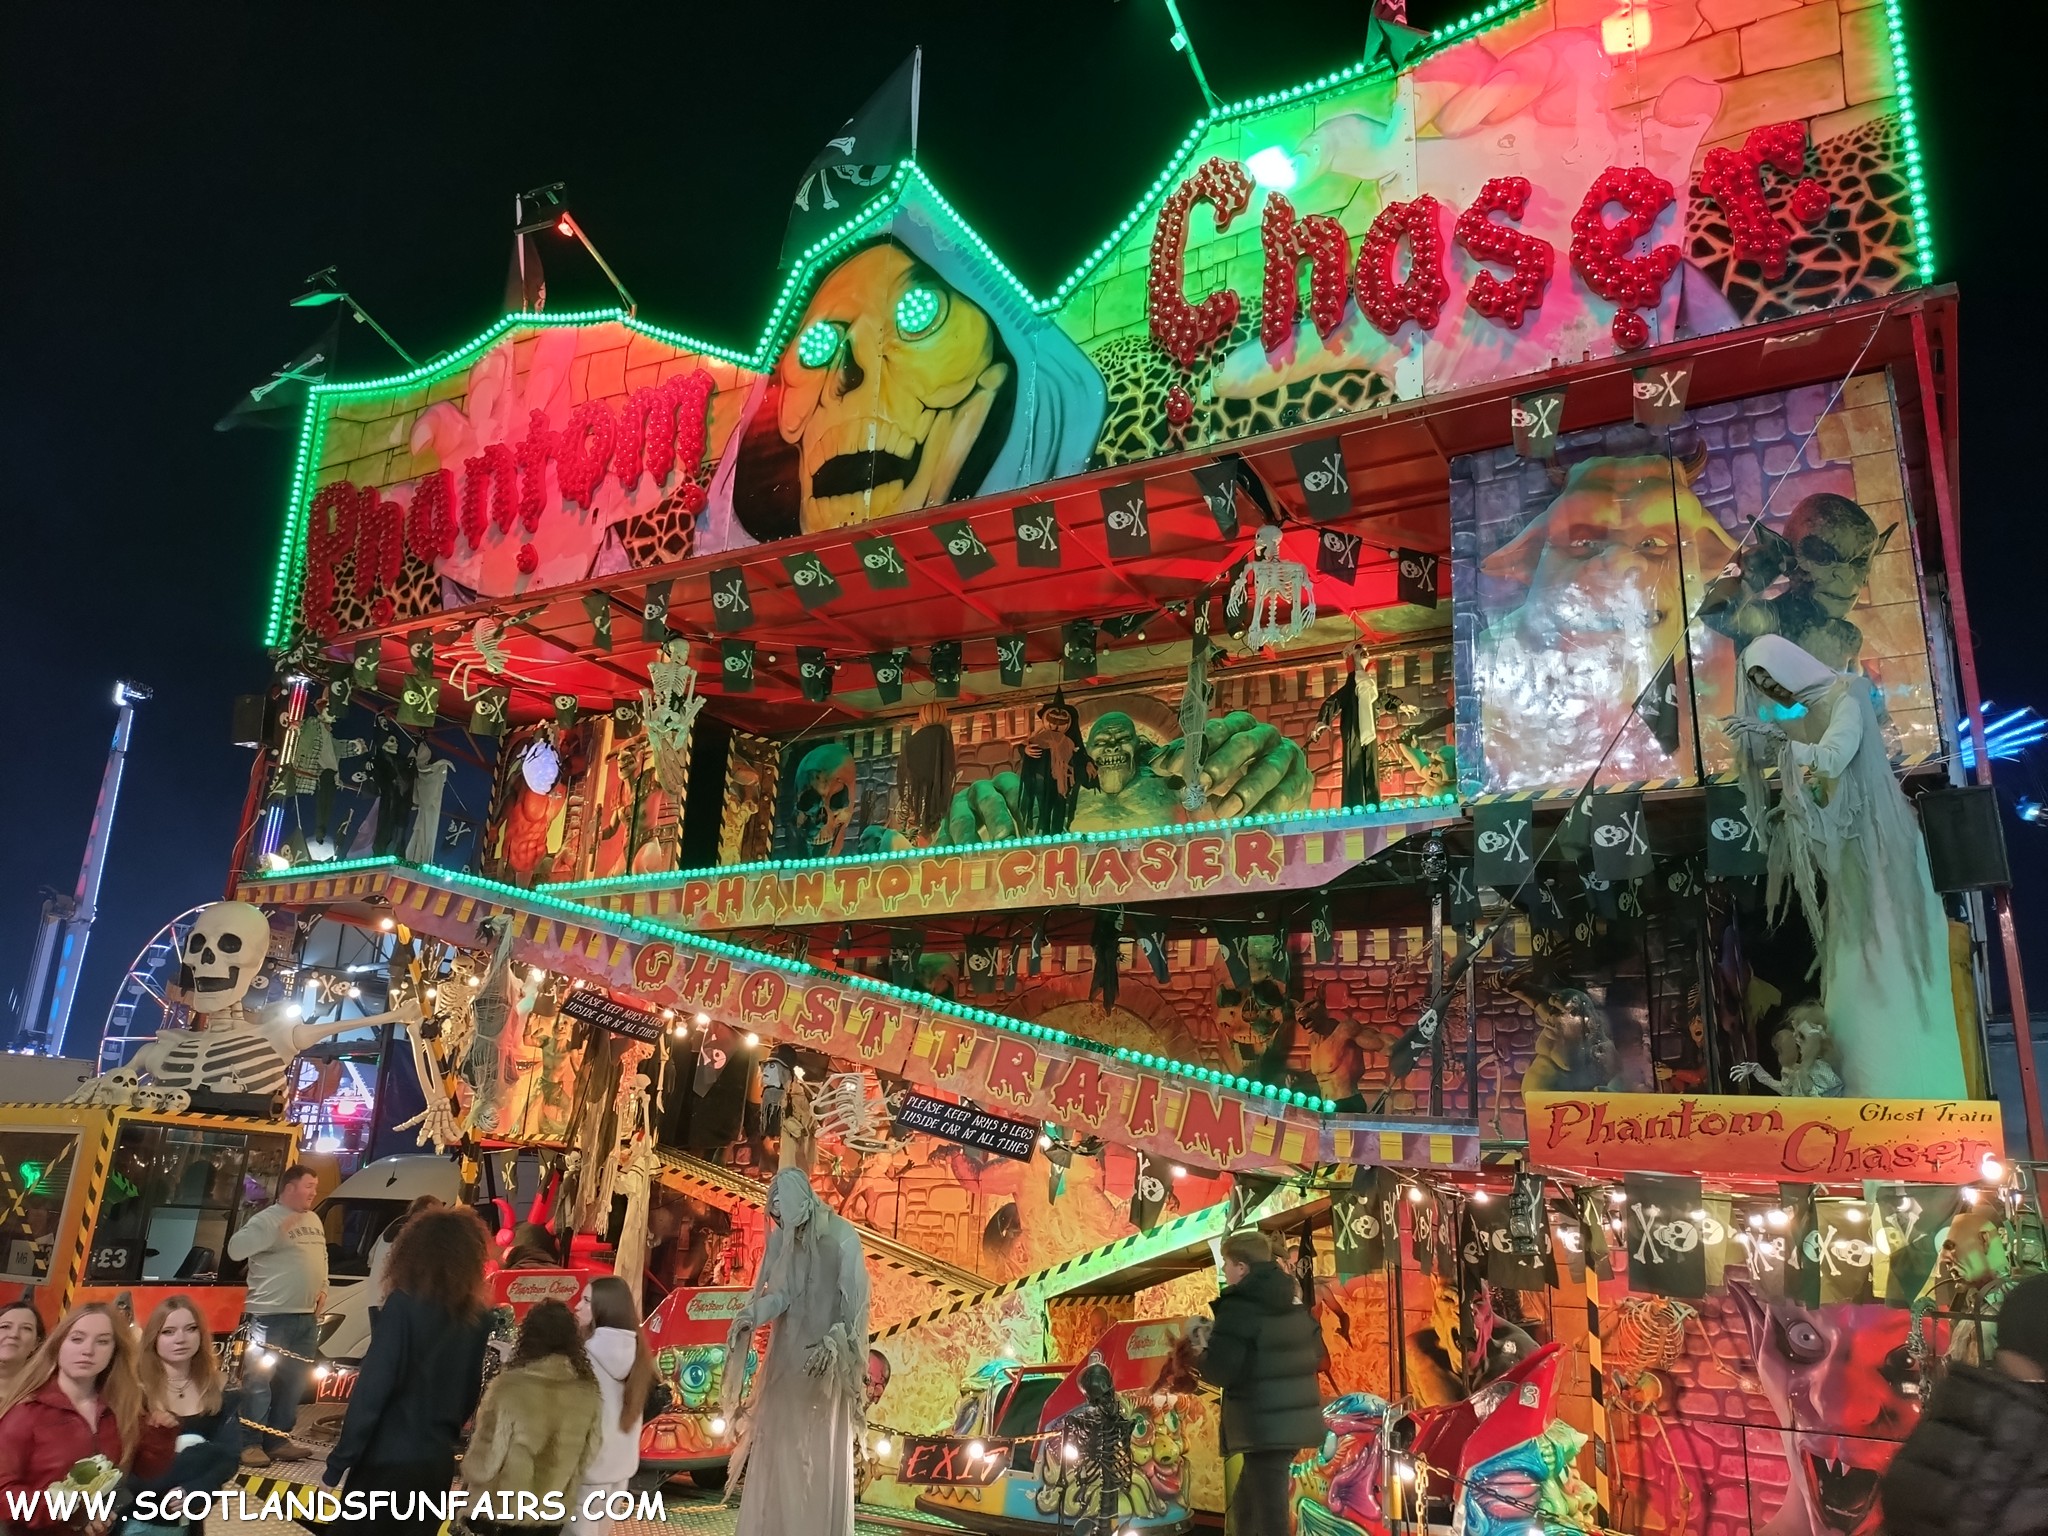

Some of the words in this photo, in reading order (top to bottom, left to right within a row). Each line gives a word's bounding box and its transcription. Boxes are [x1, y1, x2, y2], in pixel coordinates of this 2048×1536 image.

[1148, 120, 1808, 367] Chaser
[303, 368, 716, 641] Phantom
[680, 857, 963, 924] PHANTOM
[999, 829, 1284, 901] CHASER
[565, 1002, 597, 1019] INSIDE
[596, 1013, 613, 1026] CAR
[612, 1019, 624, 1029] AT
[622, 1022, 635, 1034] ALL
[635, 1026, 660, 1039] TIMES
[573, 991, 604, 1007] PLEASE
[601, 1002, 624, 1015] KEEP
[641, 1014, 649, 1023] &
[632, 942, 901, 1060] GHOST
[930, 1020, 1248, 1168] TRAIN
[901, 1110, 941, 1129] INSIDE
[940, 1122, 961, 1137] CAR
[961, 1127, 977, 1140] AT
[977, 1132, 994, 1146] ALL
[997, 1138, 1030, 1155] TIMES
[906, 1095, 945, 1115] PLEASE
[944, 1107, 972, 1122] KEEP
[972, 1115, 1000, 1131] ARMS
[1000, 1122, 1008, 1132] &
[1009, 1124, 1035, 1140] LEGS
[1544, 1098, 1784, 1149] Phantom
[1859, 1102, 1924, 1123] Ghost
[1934, 1103, 1994, 1122] Train
[1781, 1120, 1993, 1174] Chaser
[97, 1248, 127, 1268] £3
[1524, 1385, 1539, 1406] 3
[906, 1444, 1009, 1481] EXIT
